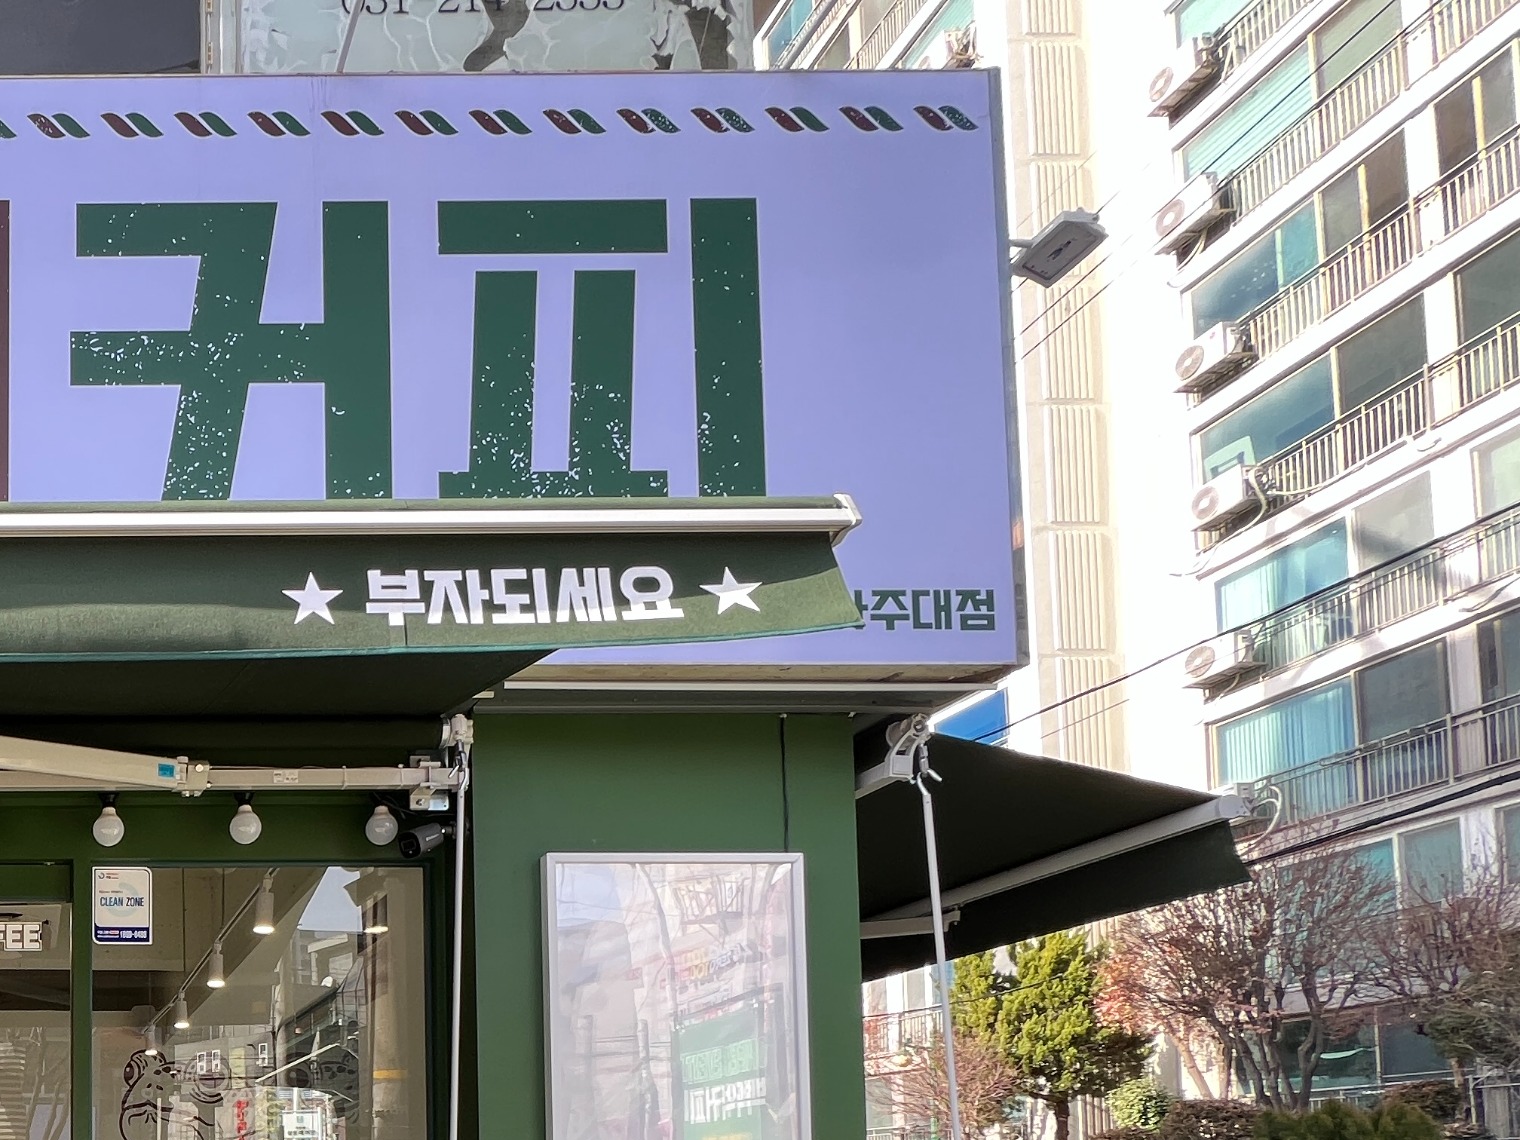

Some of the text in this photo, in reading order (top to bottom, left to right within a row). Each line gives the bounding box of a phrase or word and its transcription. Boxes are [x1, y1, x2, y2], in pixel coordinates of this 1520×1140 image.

[70, 197, 767, 501] 커피
[365, 565, 685, 627] 부자되세요
[99, 896, 145, 907] CLEAN ZONE
